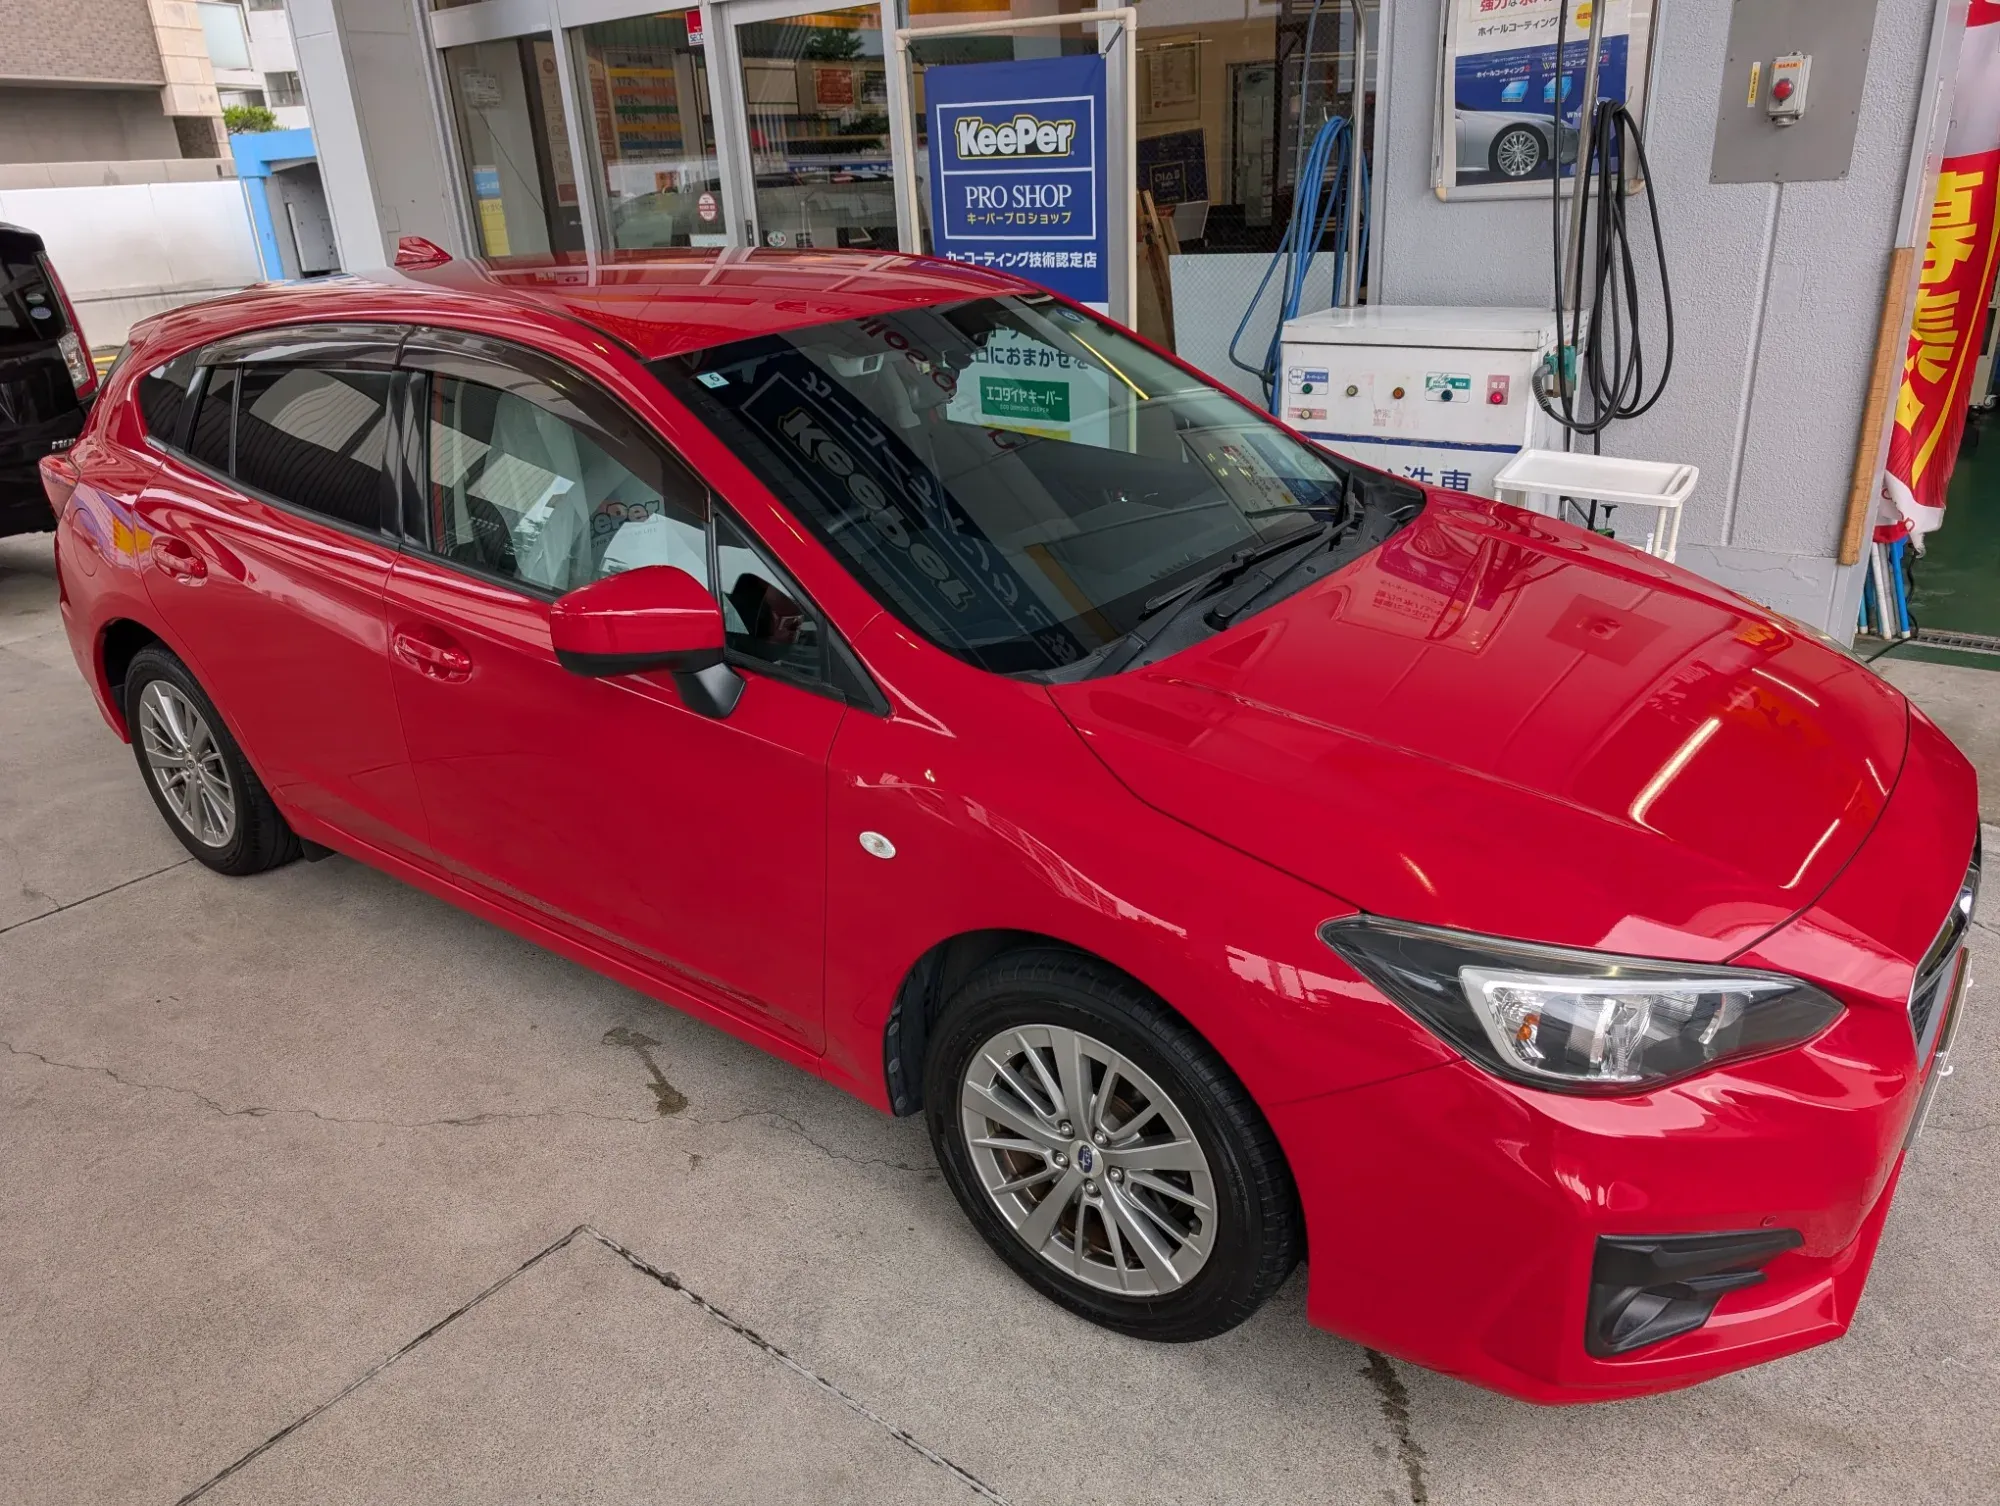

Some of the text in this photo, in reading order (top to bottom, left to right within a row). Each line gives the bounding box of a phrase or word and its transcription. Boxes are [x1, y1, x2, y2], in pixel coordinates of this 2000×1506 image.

[956, 116, 1075, 158] KeePer
[964, 184, 1073, 209] PRO SHOP
[985, 385, 1063, 406] エコダイヤキーパー
